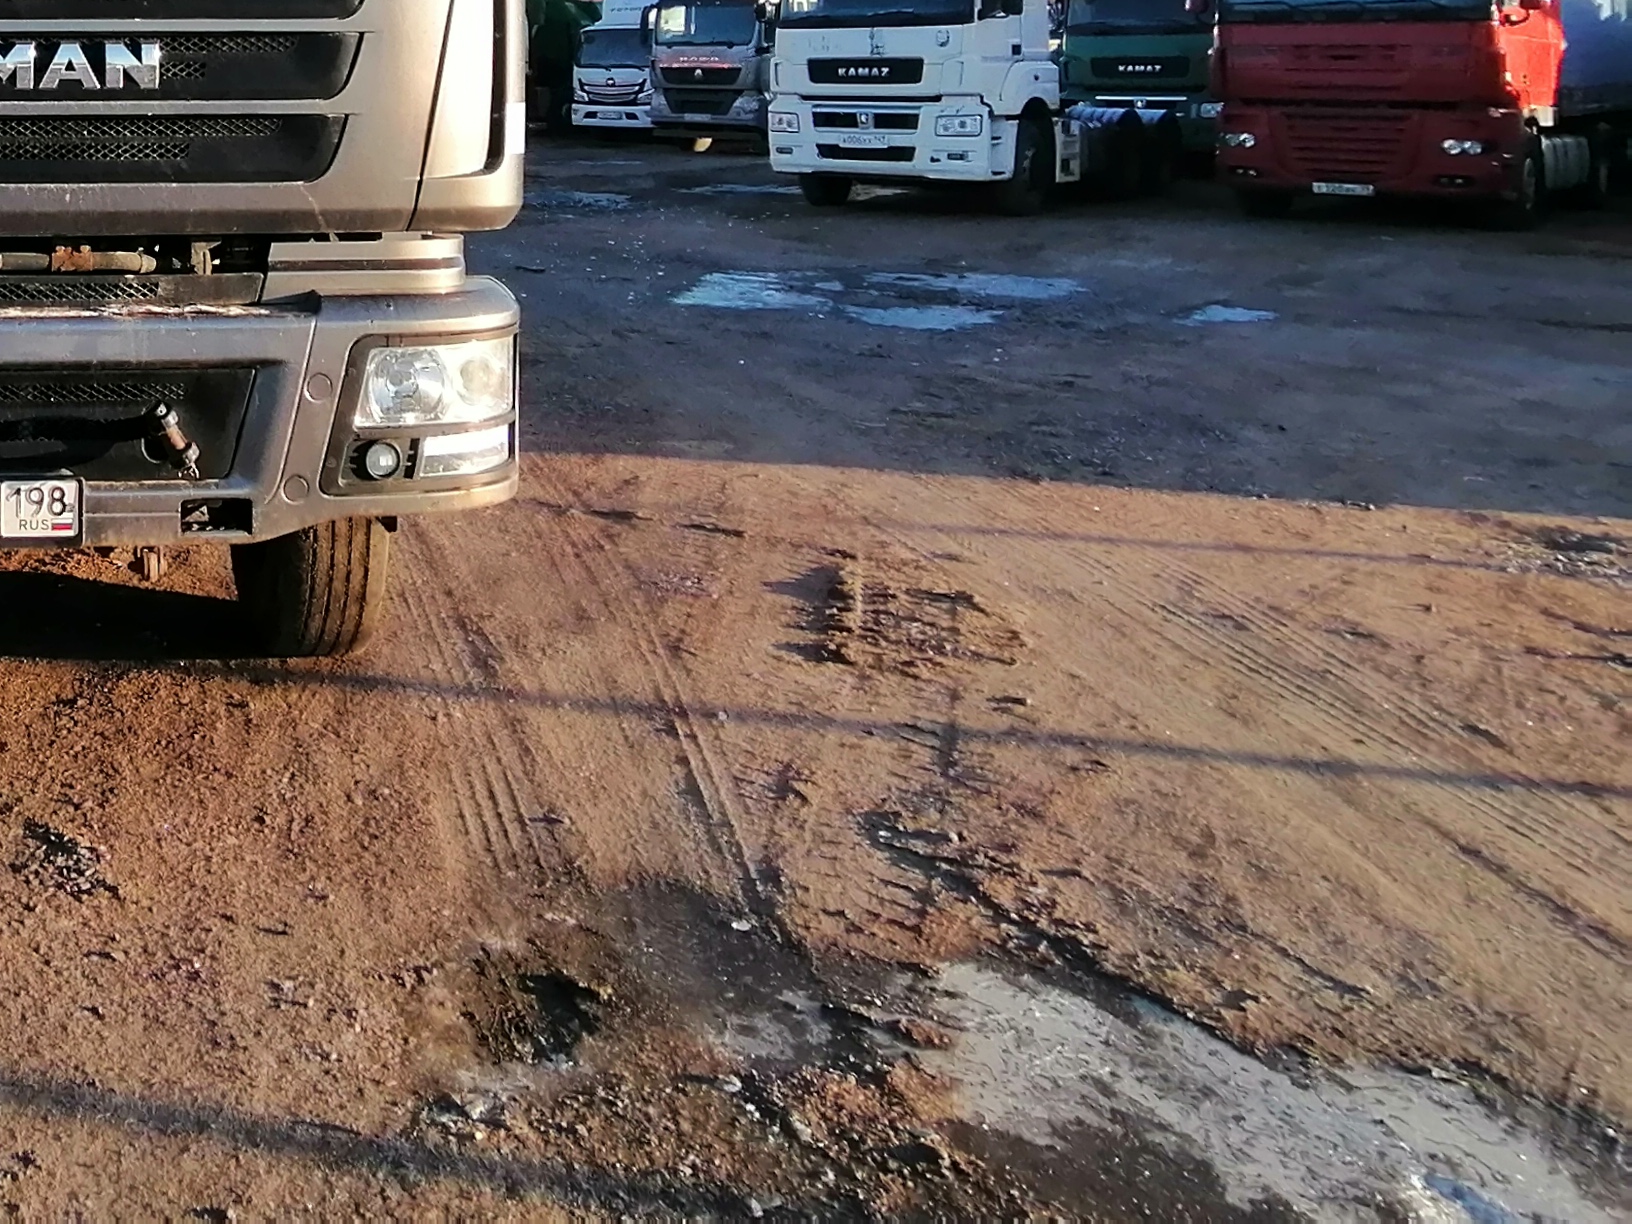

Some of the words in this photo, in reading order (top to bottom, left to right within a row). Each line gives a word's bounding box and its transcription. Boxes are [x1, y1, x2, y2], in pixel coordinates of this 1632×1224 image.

[837, 67, 890, 77] KAMAZ
[5, 486, 67, 517] 198
[18, 519, 50, 531] RUS
